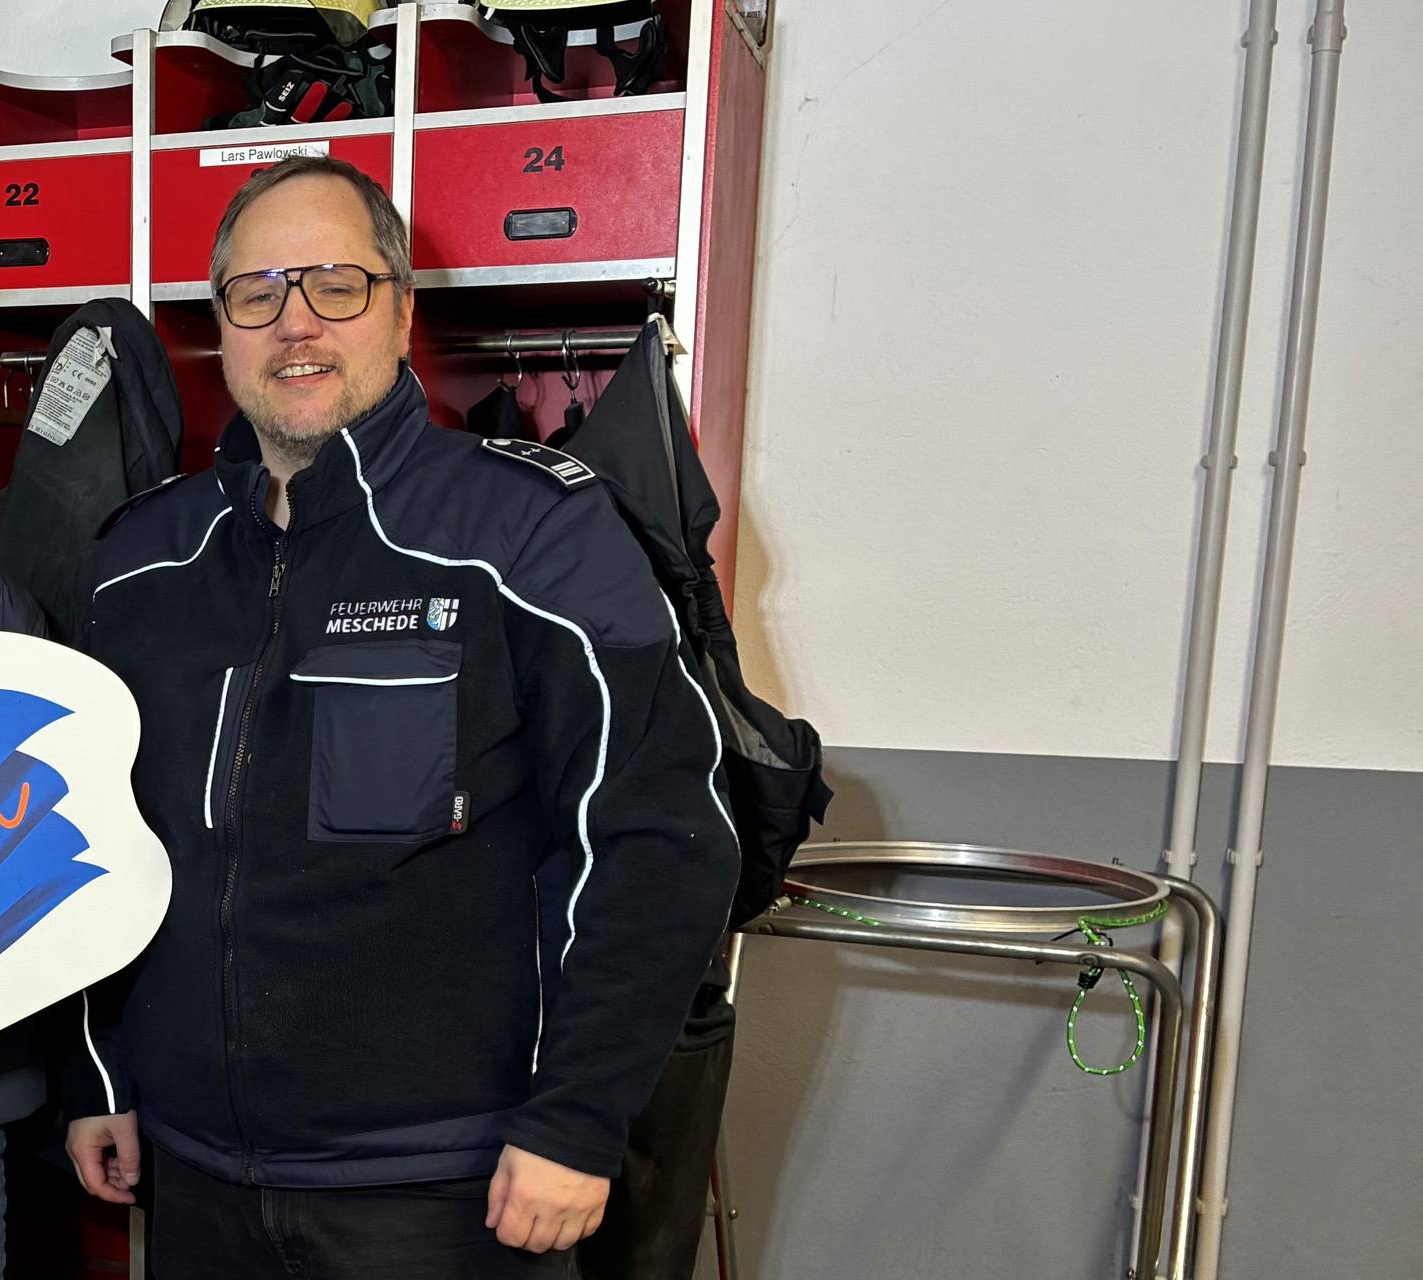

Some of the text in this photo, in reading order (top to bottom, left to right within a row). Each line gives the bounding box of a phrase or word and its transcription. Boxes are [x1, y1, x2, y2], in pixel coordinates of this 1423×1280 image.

[221, 145, 308, 162] Lars Pawlowski
[523, 146, 565, 173] 24
[5, 182, 40, 206] 22
[330, 598, 423, 616] FEUERWEHR
[325, 614, 419, 634] MESCHEDE
